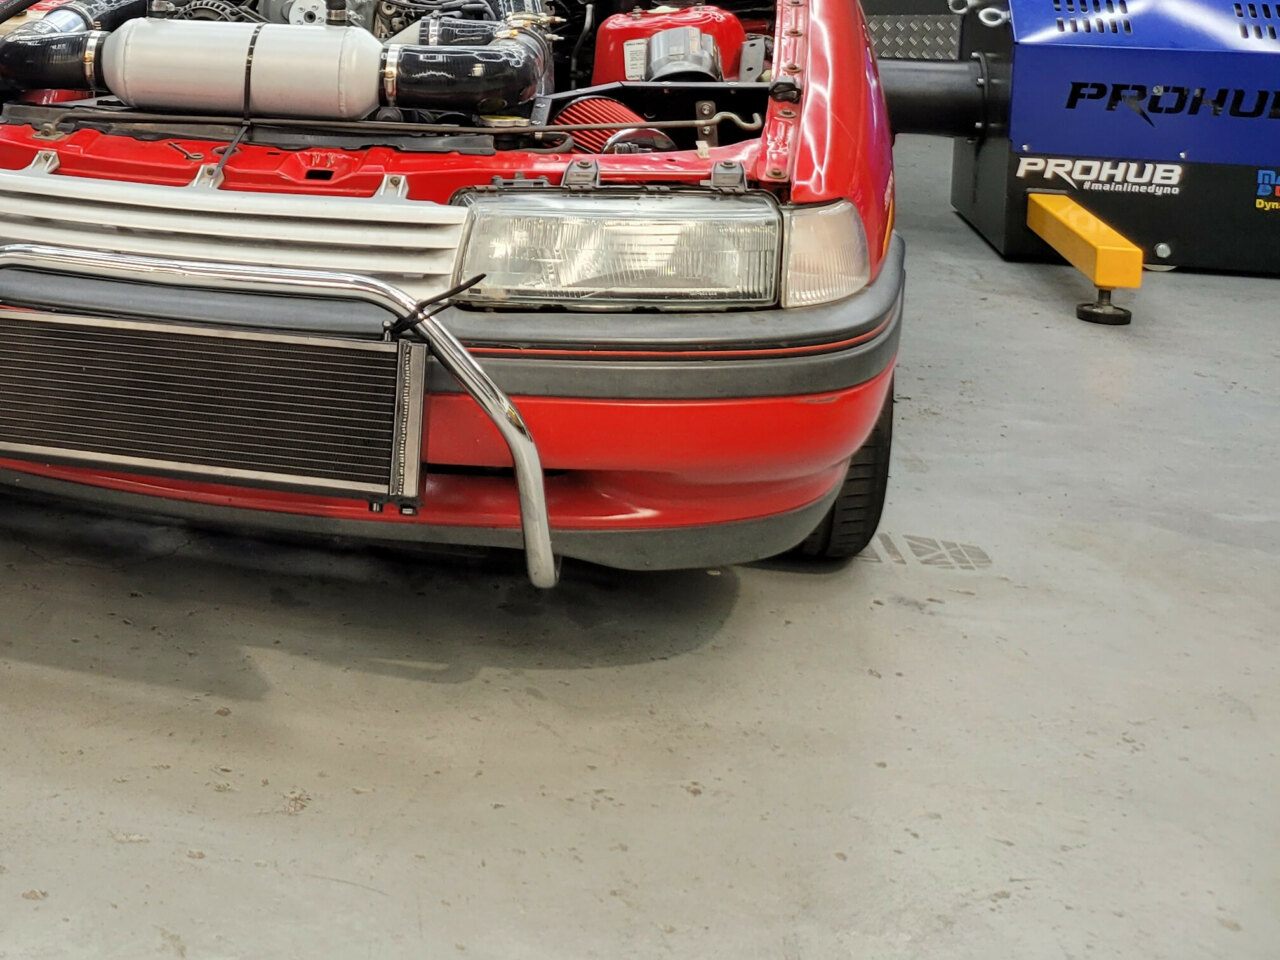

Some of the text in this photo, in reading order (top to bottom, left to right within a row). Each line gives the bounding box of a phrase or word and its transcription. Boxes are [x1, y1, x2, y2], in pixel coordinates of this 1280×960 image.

[1066, 82, 1280, 127] PROHU
[1016, 157, 1183, 189] PROHUB
[1083, 180, 1180, 195] #mainlinedyno
